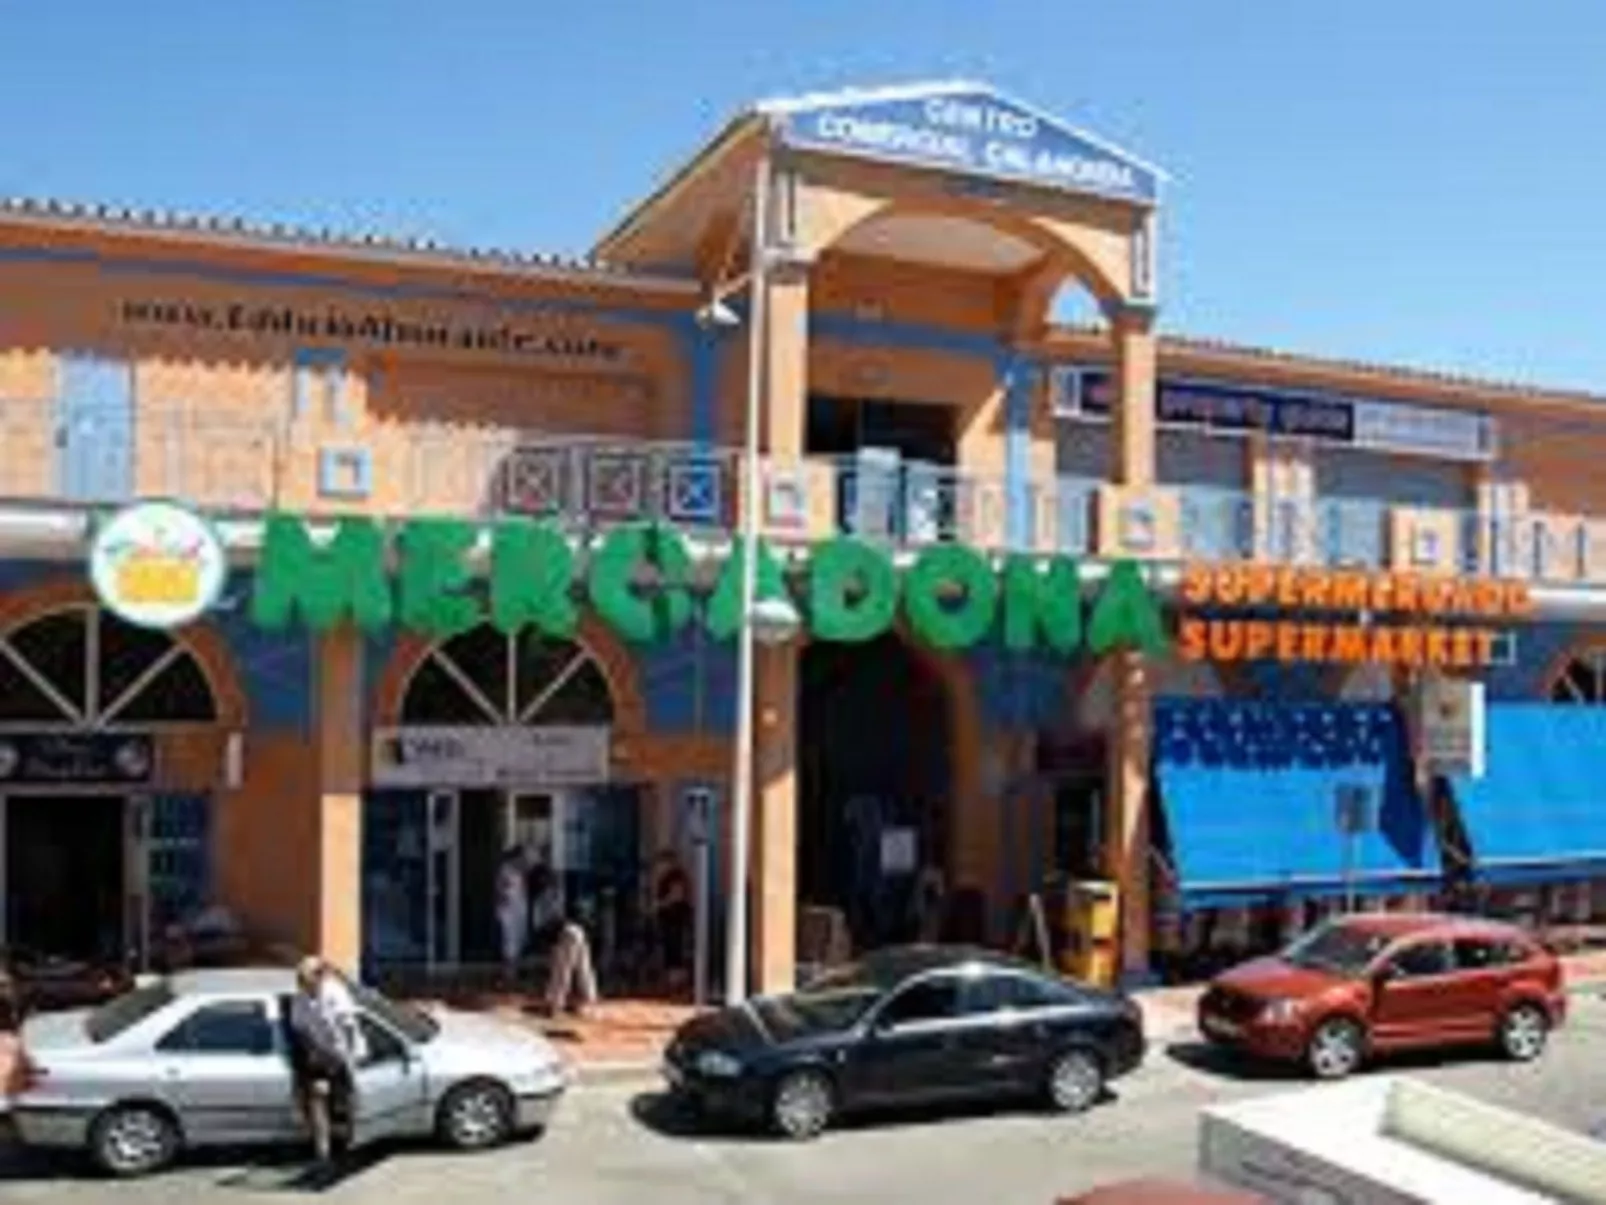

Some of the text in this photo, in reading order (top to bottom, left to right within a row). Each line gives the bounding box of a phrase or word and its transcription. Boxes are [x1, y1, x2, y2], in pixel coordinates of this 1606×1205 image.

[818, 112, 974, 164] COMERCIAL
[924, 98, 1038, 140] CENTRO
[252, 512, 1168, 656] MERCADONA
[1181, 564, 1532, 616] SUPERMERCADO
[1180, 618, 1493, 667] SUPERMARKET
